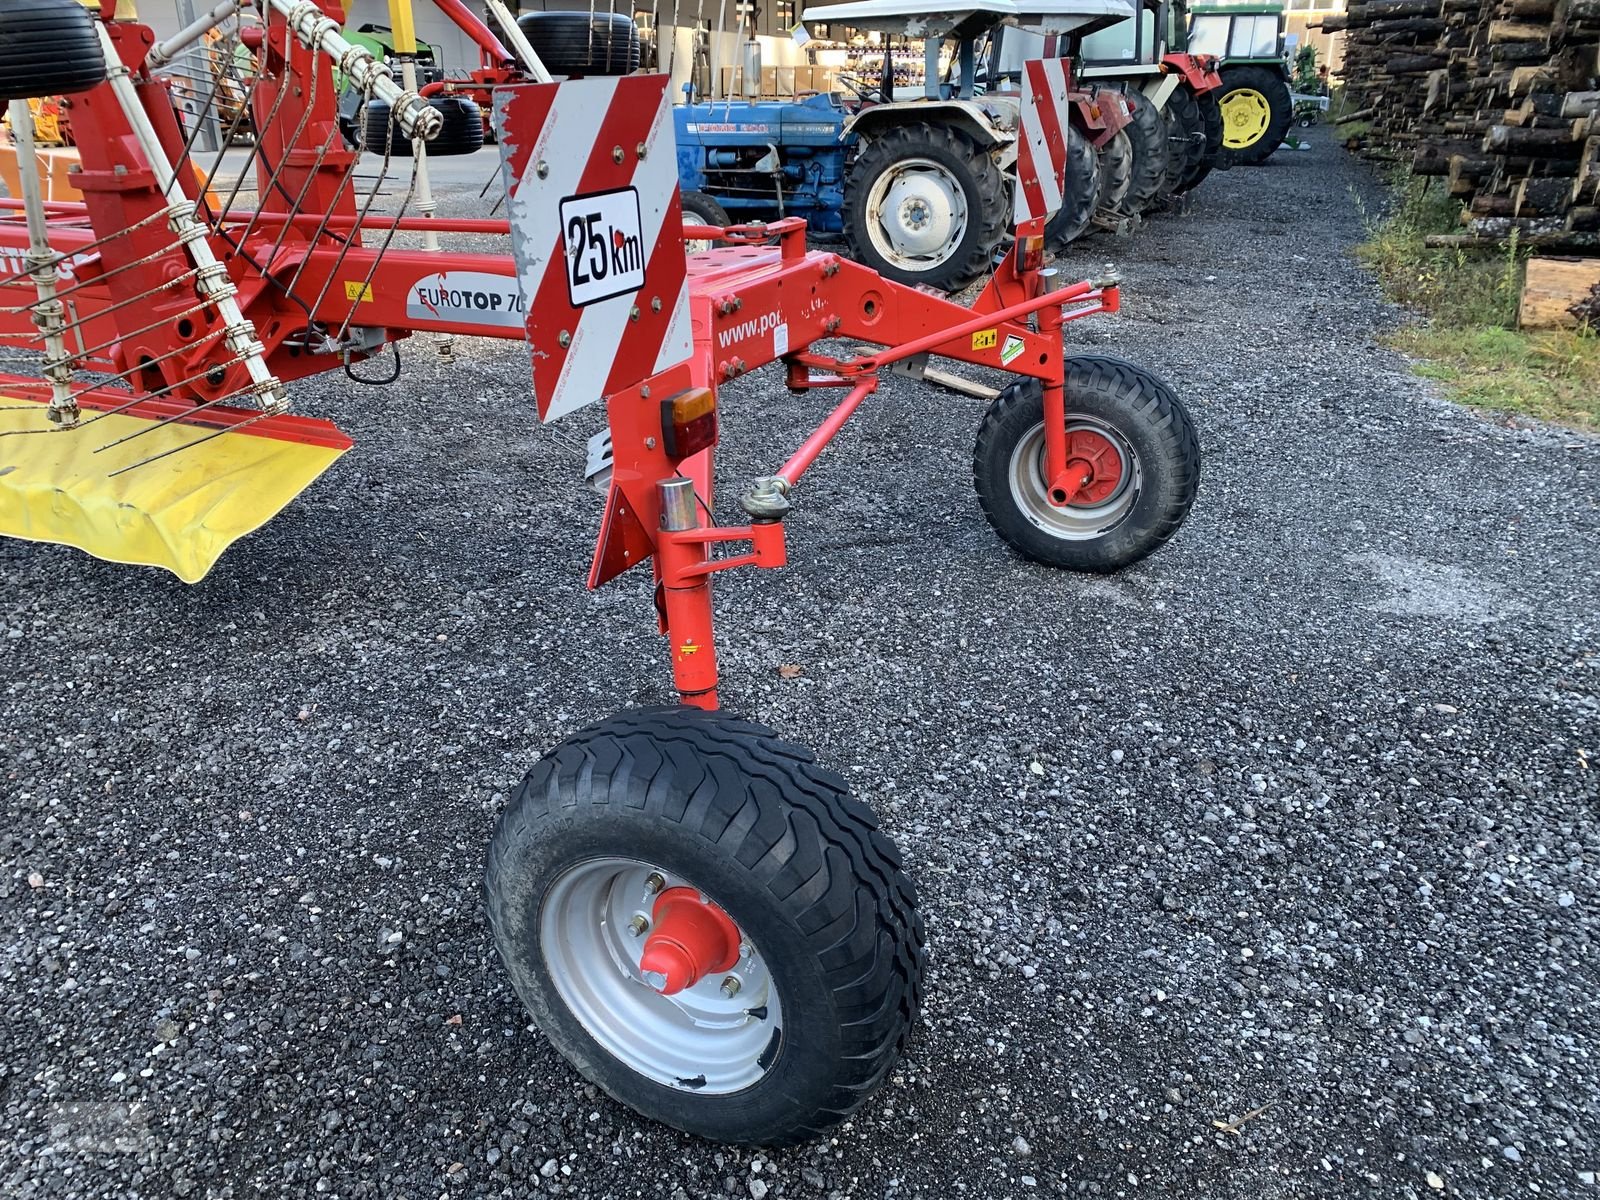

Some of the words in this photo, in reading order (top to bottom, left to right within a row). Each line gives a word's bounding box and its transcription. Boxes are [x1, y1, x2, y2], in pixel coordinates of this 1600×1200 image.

[568, 212, 608, 286] 25
[609, 225, 641, 276] km
[418, 288, 502, 310] EUROTOP
